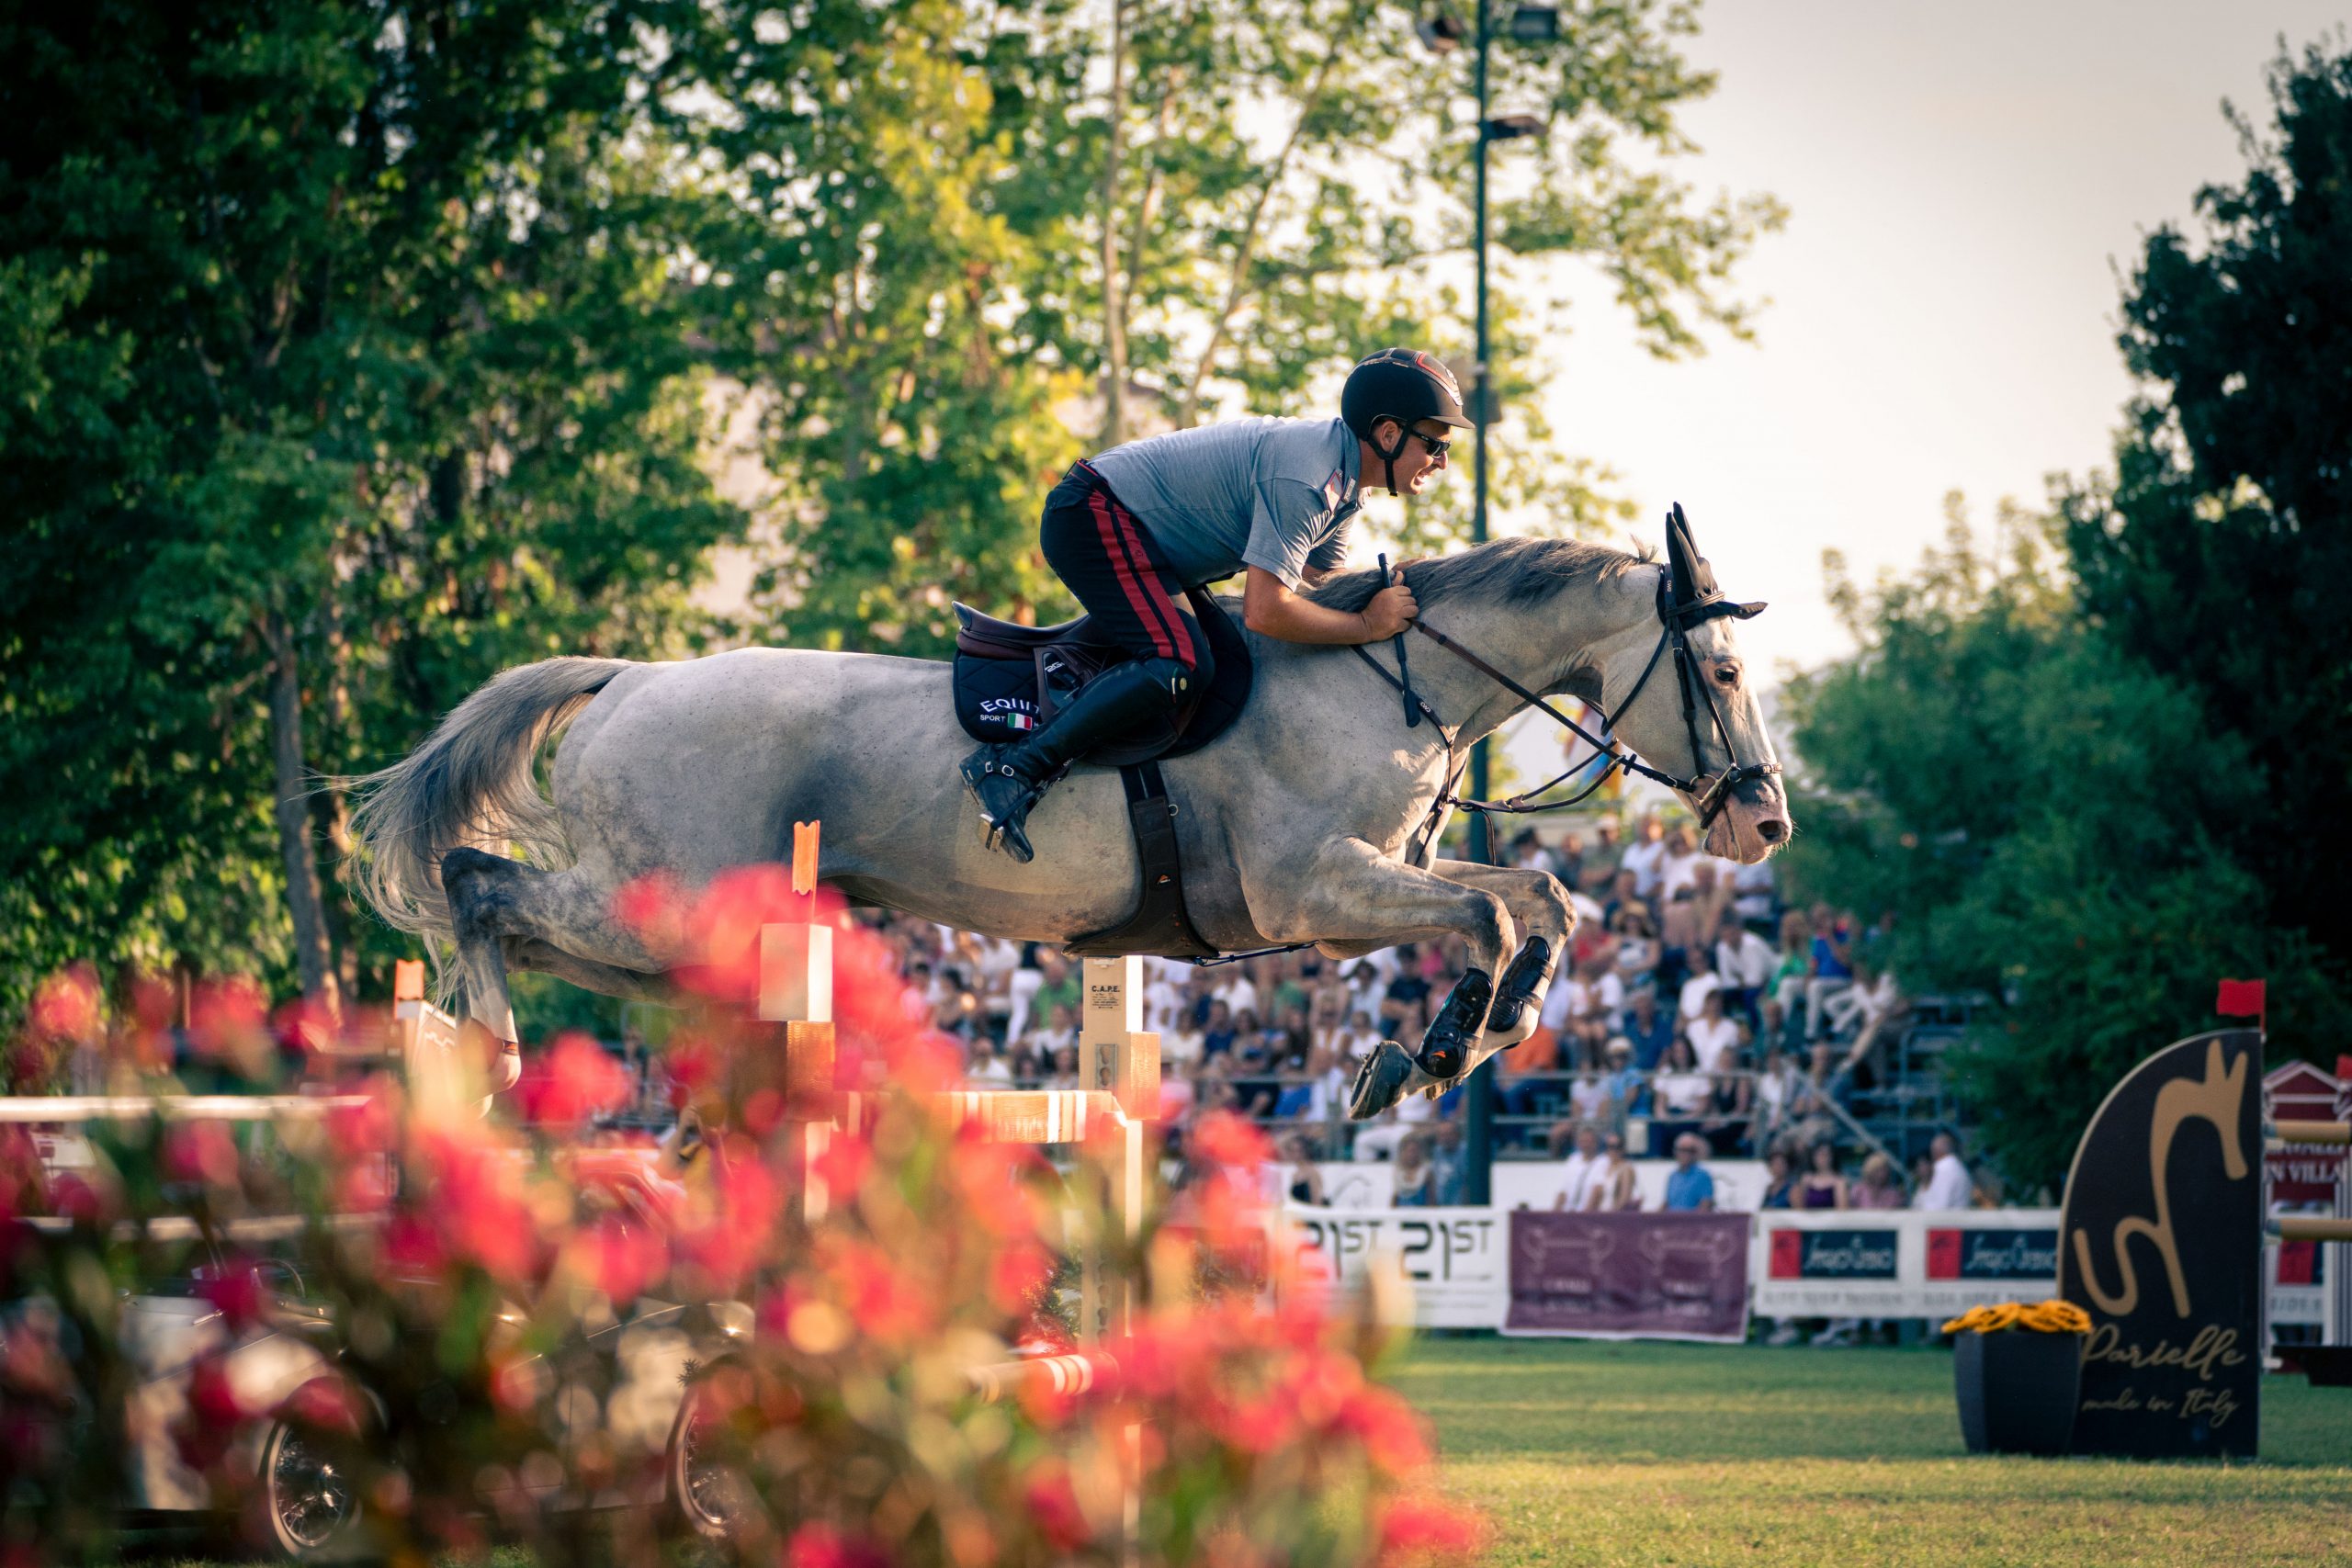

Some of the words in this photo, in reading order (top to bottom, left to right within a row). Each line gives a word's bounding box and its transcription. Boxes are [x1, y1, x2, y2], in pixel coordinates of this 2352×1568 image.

[979, 714, 1006, 723] SPORT
[1091, 985, 1120, 993] C.A.P.E.
[1400, 1220, 1494, 1281] 21ST
[2146, 1395, 2175, 1412] in
[2178, 1388, 2241, 1428] Italy
